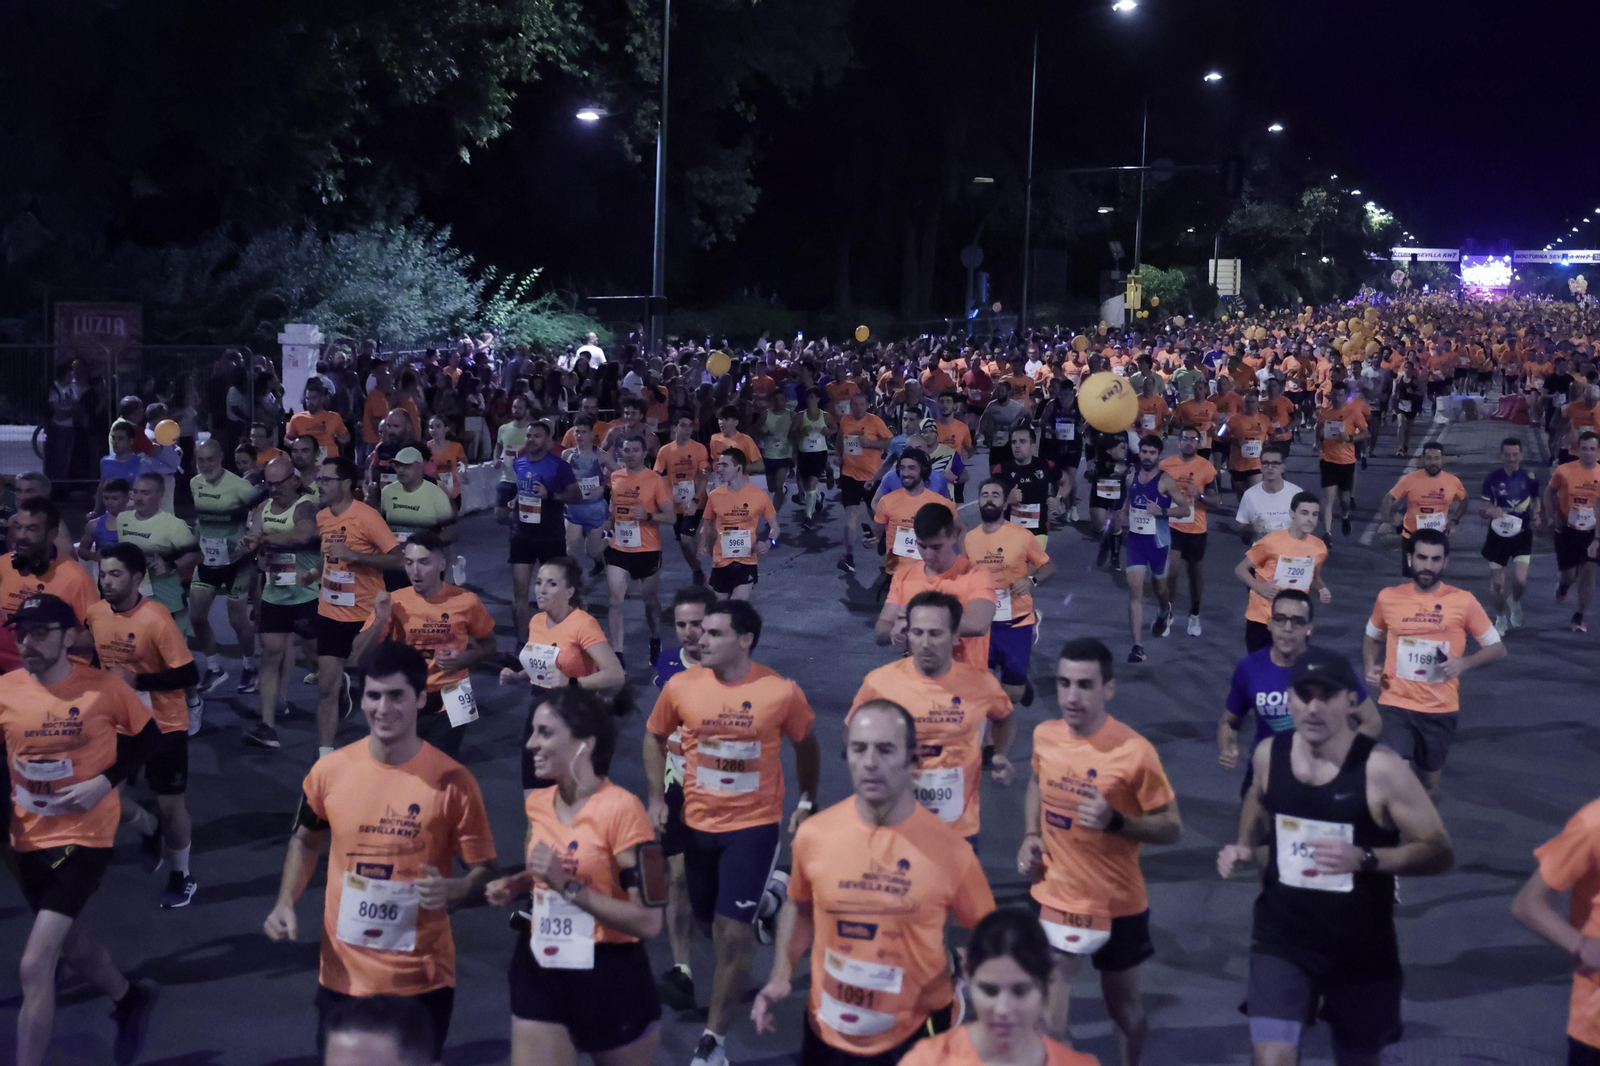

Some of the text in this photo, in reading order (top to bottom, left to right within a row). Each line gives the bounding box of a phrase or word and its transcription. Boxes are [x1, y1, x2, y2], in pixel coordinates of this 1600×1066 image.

[729, 539, 745, 547] 5968
[204, 546, 221, 556] 9226
[1286, 567, 1305, 576] 7200
[528, 657, 547, 671] 9934
[25, 728, 60, 738] SEVILLA
[42, 721, 84, 732] NOCTURNA
[715, 757, 747, 774] 1286
[914, 787, 953, 802] 10090
[379, 817, 423, 831] NOCTURNA
[358, 824, 420, 839] SEVILLA KH7
[358, 900, 399, 922] 8036
[540, 917, 573, 937] 8038
[836, 983, 876, 1008] 1091
